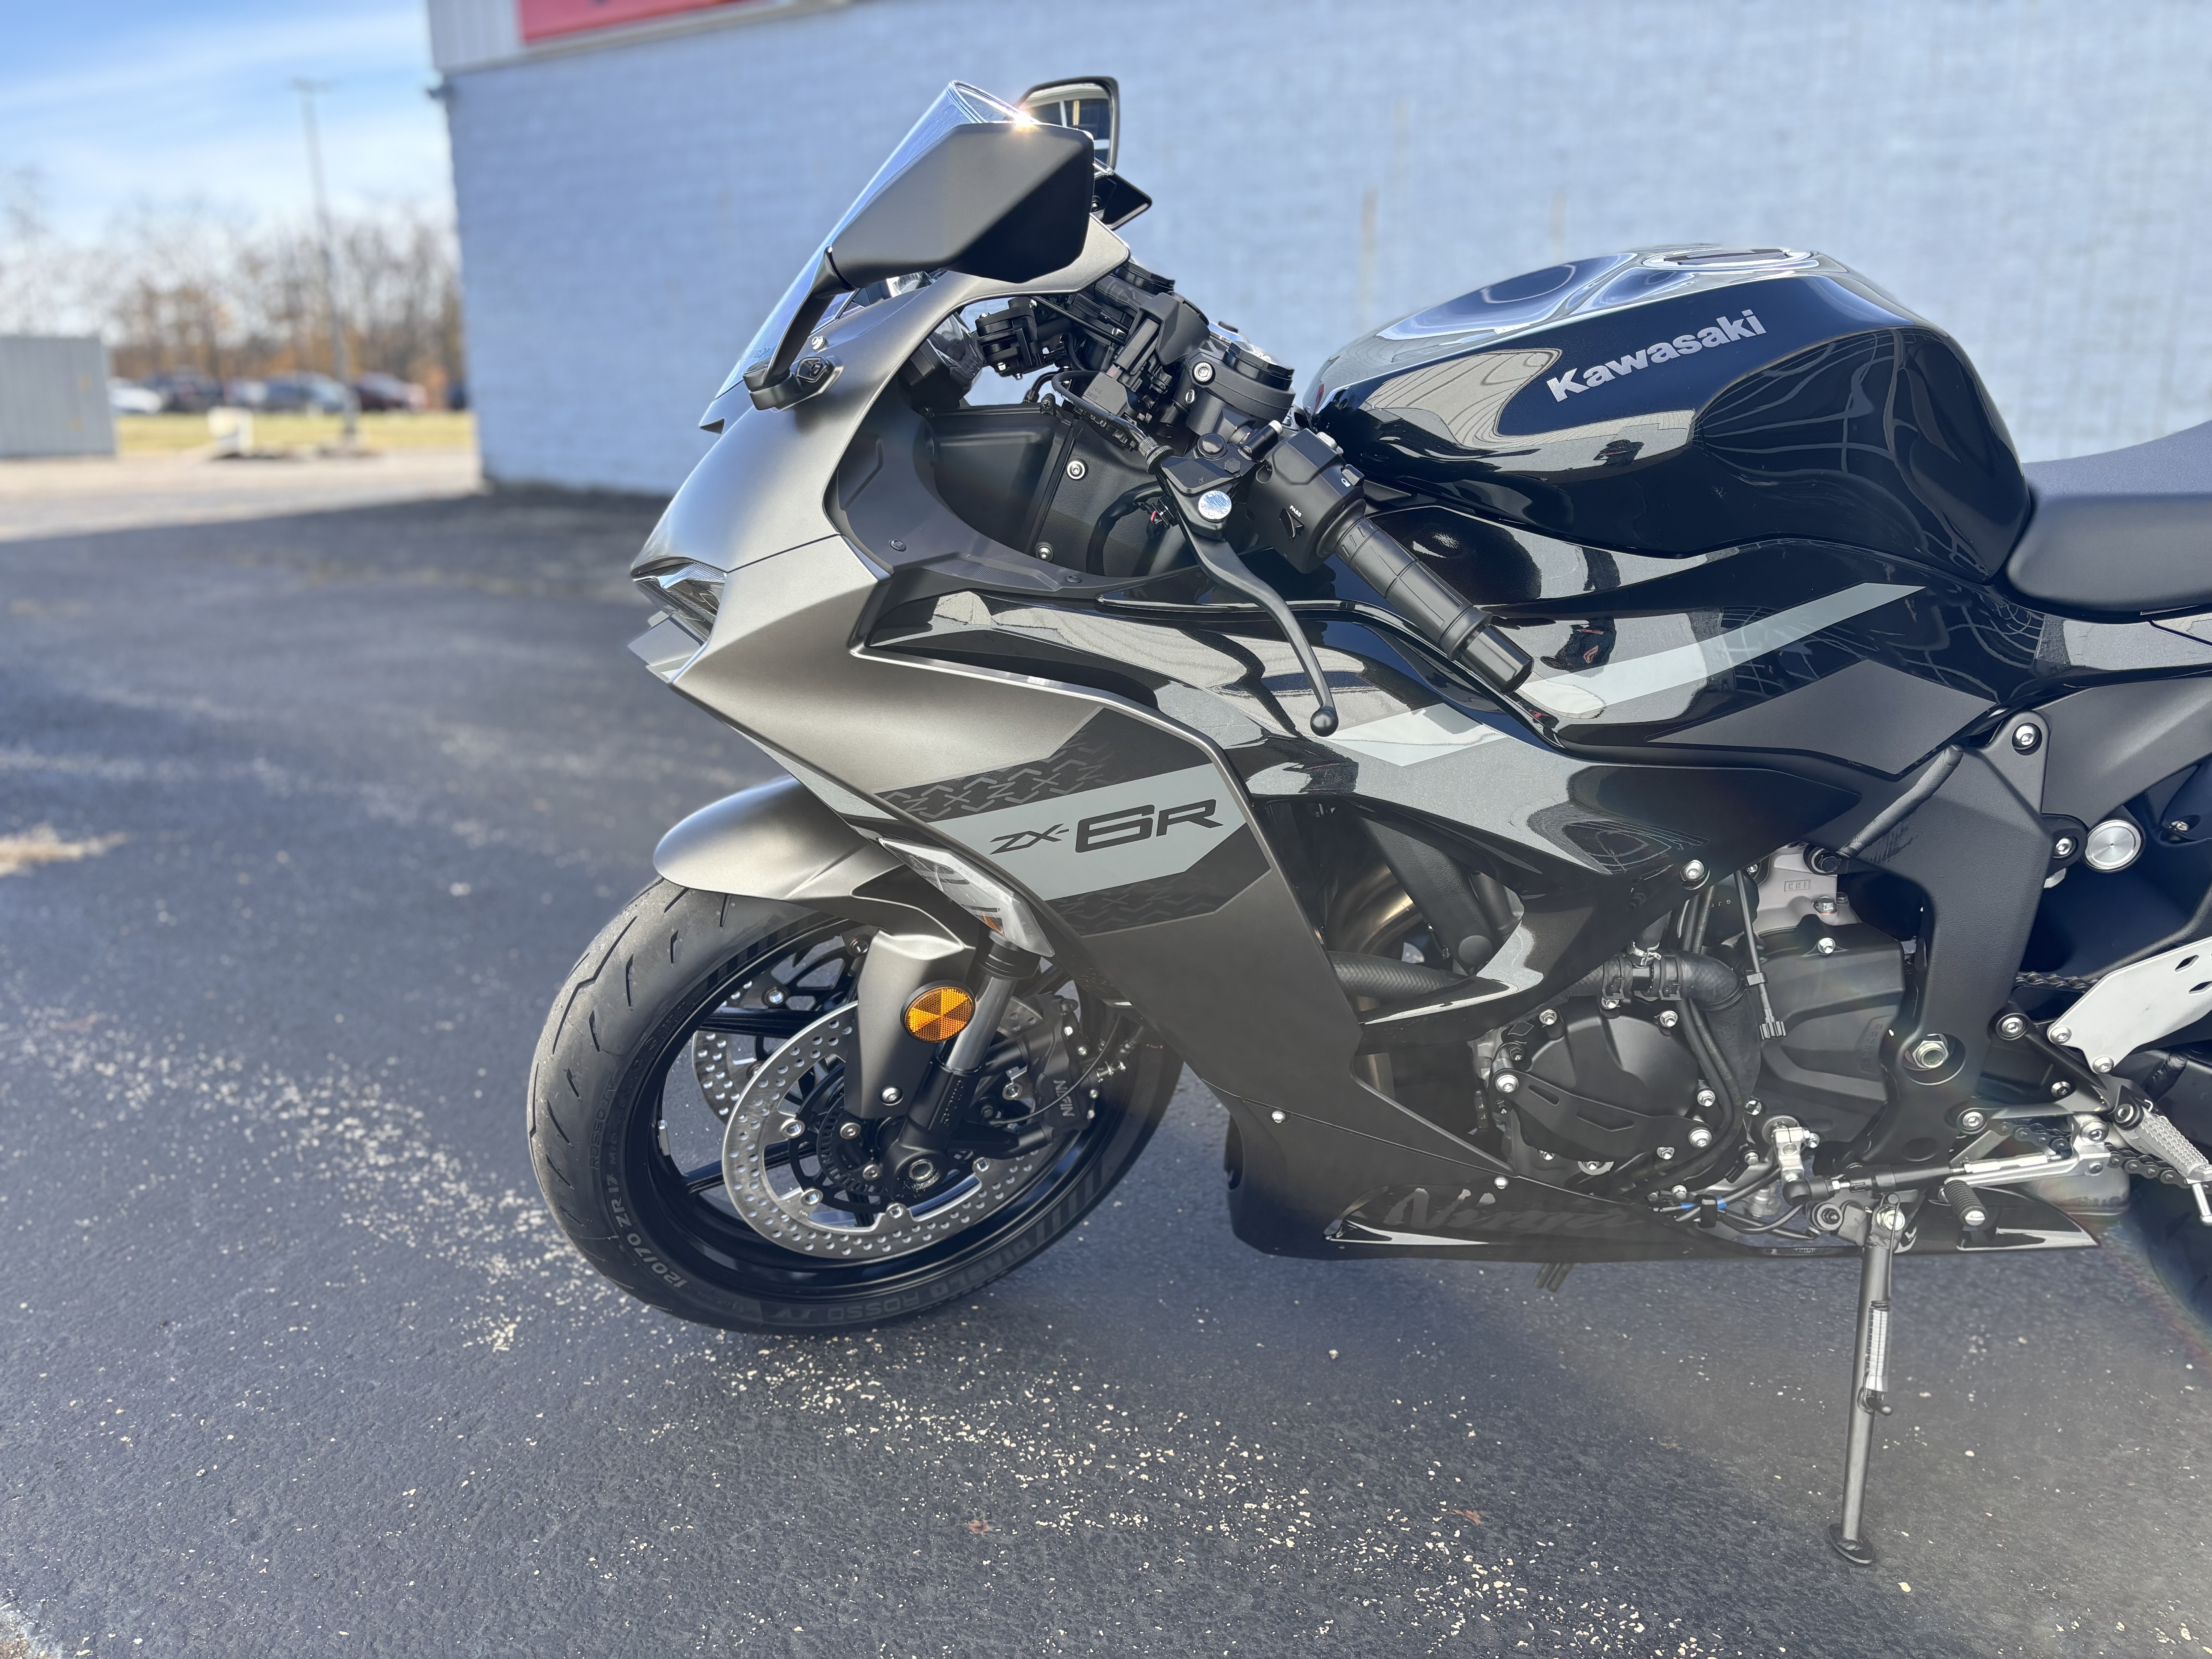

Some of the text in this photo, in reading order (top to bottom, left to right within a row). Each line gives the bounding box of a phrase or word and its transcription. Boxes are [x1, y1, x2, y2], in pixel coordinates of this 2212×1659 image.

[1546, 309, 1767, 403] Kawasaki
[1290, 505, 1302, 517] PASS
[1053, 1079, 1075, 1116] NIIN
[607, 1174, 620, 1194] 17
[611, 1196, 630, 1228] ZR
[627, 1233, 688, 1288] 120/70
[929, 1239, 1030, 1297] DIABLO
[828, 1292, 919, 1321] ROSSO
